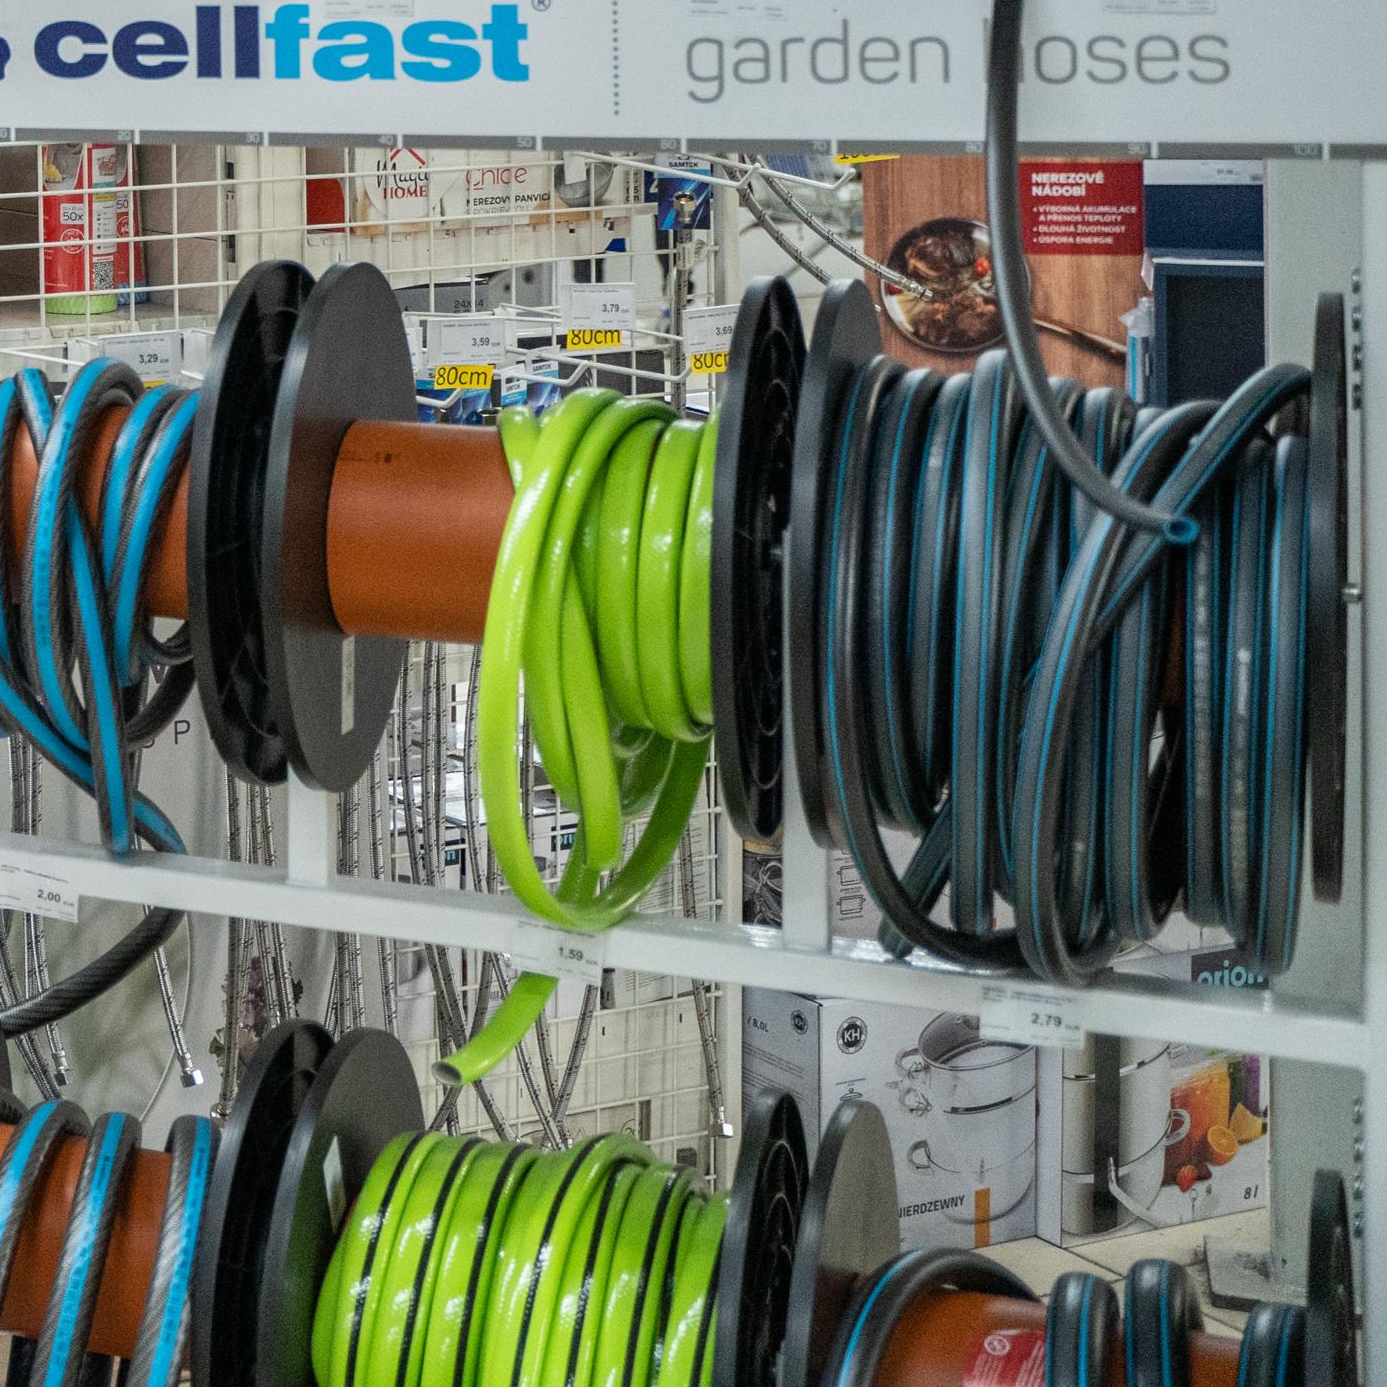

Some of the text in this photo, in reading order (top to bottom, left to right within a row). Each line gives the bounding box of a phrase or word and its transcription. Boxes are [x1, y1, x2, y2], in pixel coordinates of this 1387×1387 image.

[33, 3, 530, 83] cellfast
[685, 17, 951, 104] garden
[1031, 170, 1105, 184] NEREZOVÉ
[1031, 184, 1087, 197] NÁDOBÍ
[62, 211, 84, 222] 50x
[602, 303, 620, 314] 3,79
[471, 336, 490, 347] 3,59
[570, 329, 621, 346] 80cm
[138, 353, 159, 365] 3,29
[435, 366, 488, 386] 80cm
[37, 889, 62, 904] 2,00
[558, 945, 584, 962] 1,59
[1031, 1011, 1062, 1029] 2,79
[844, 1028, 861, 1043] KH
